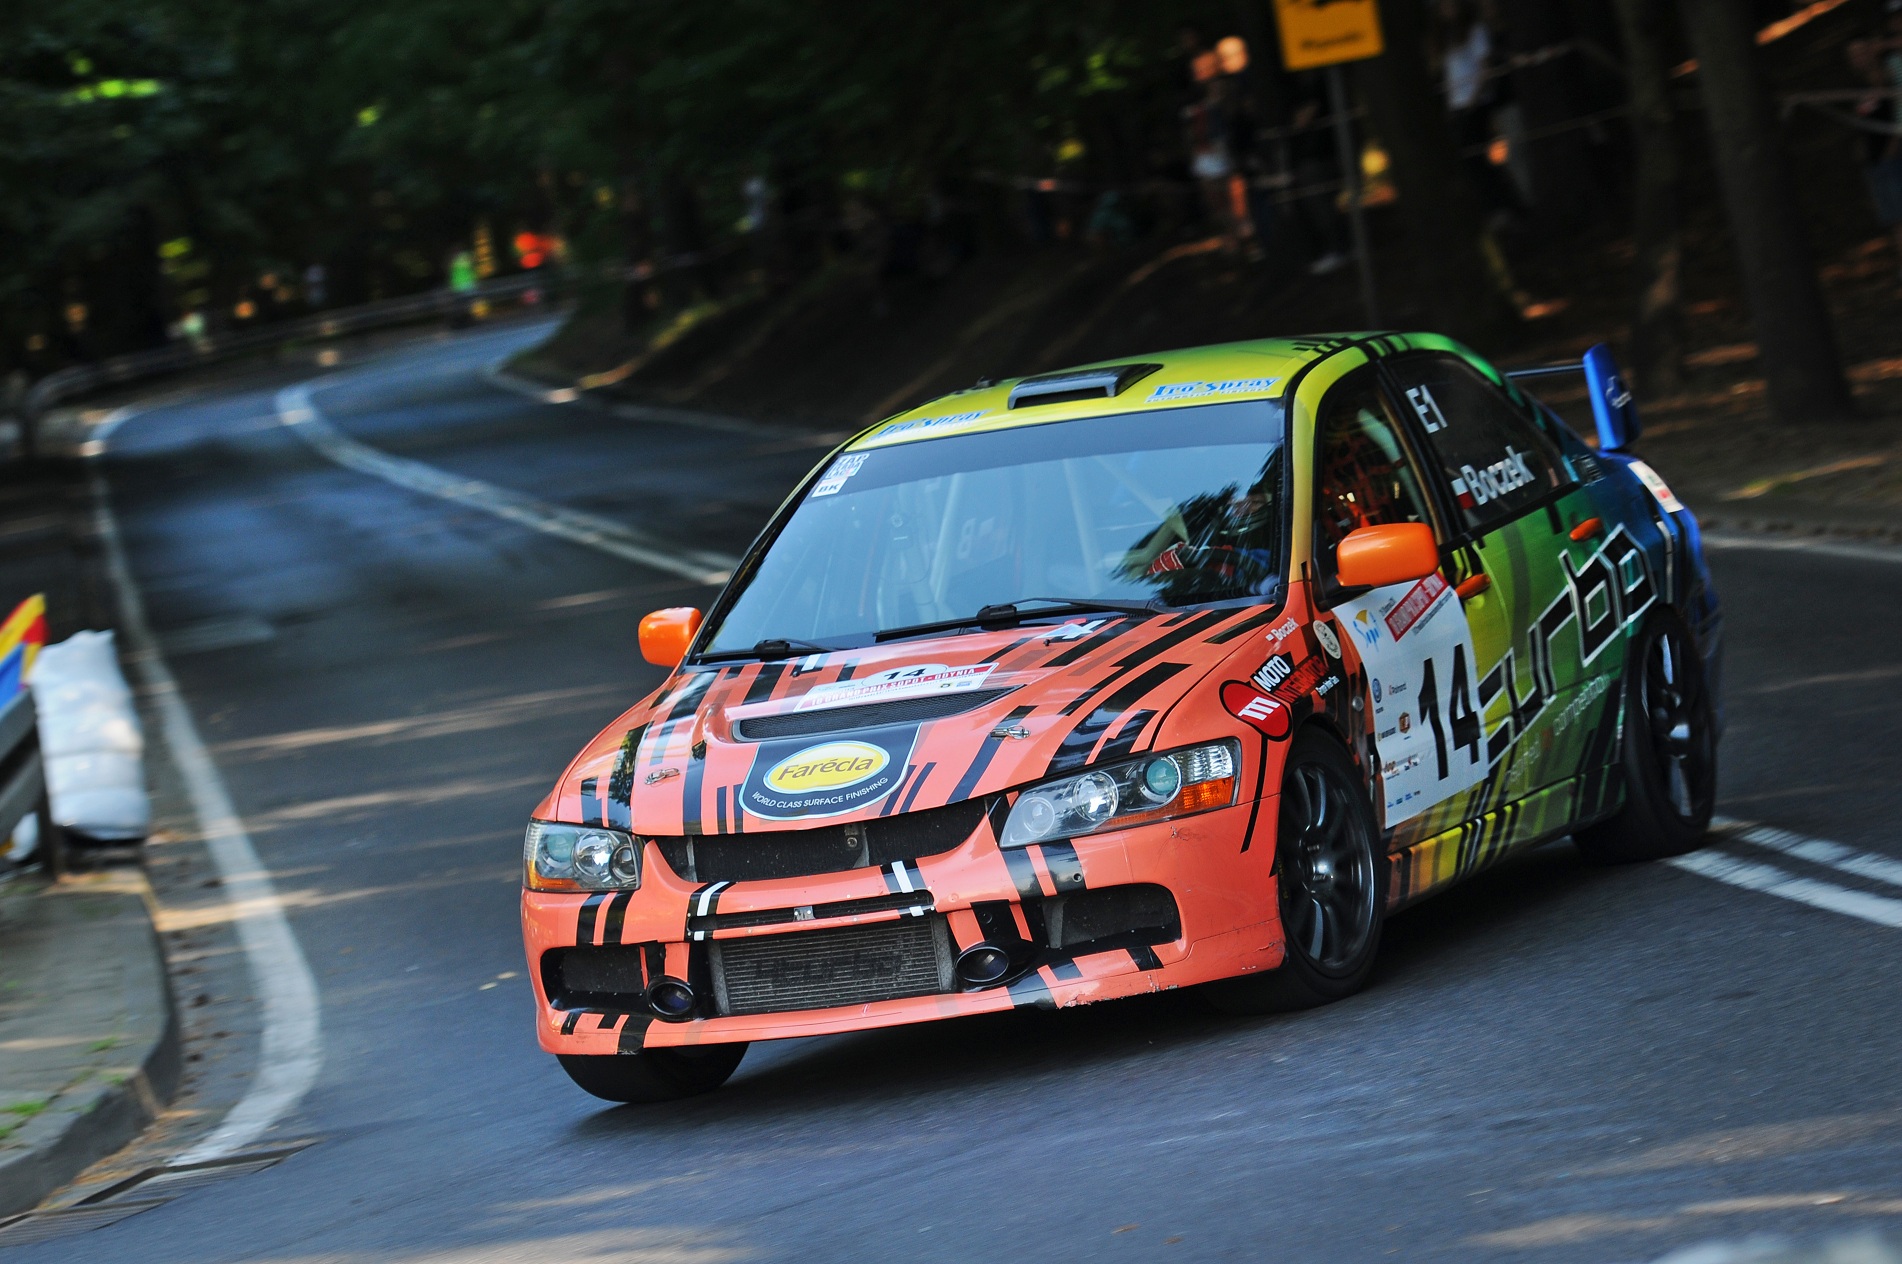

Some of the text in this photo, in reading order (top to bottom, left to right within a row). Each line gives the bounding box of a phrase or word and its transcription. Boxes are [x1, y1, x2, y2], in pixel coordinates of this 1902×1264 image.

[1405, 384, 1448, 434] E1
[1460, 445, 1536, 506] Boczek
[1270, 617, 1299, 641] Boczek
[862, 682, 888, 694] PRIX
[890, 676, 926, 688] SOPOT
[934, 668, 975, 680] GDYNIA
[884, 667, 927, 680] 14
[1253, 655, 1291, 692] MOTO
[1418, 643, 1482, 781] 14
[778, 757, 873, 781] Farécla
[751, 777, 889, 809] WORLD CLASS SURFACE FINISHING
